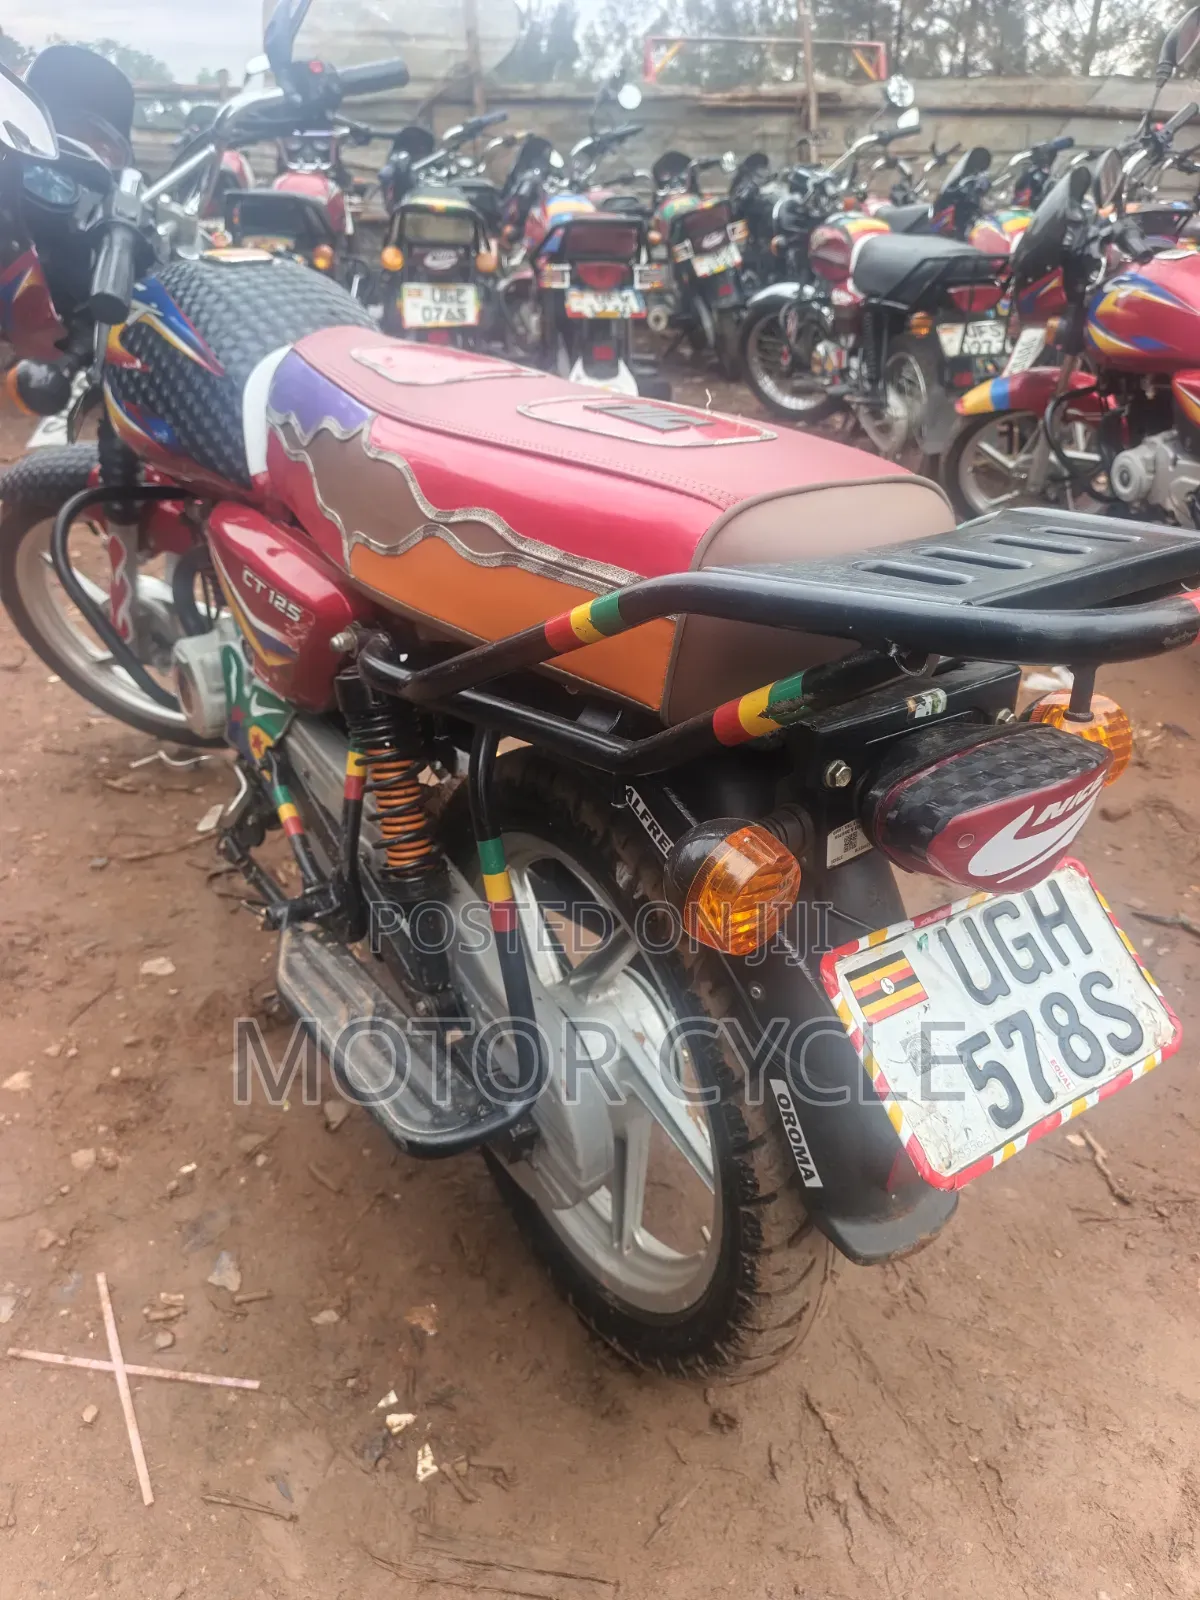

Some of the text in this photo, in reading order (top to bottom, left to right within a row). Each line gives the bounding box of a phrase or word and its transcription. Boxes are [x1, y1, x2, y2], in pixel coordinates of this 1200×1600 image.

[243, 569, 303, 622] CT 125
[626, 789, 674, 857] ALFRE
[936, 879, 1093, 1006] UGH
[956, 971, 1144, 1130] 578S
[1050, 1059, 1072, 1090] EQUAL
[776, 1092, 816, 1182] OROMA
